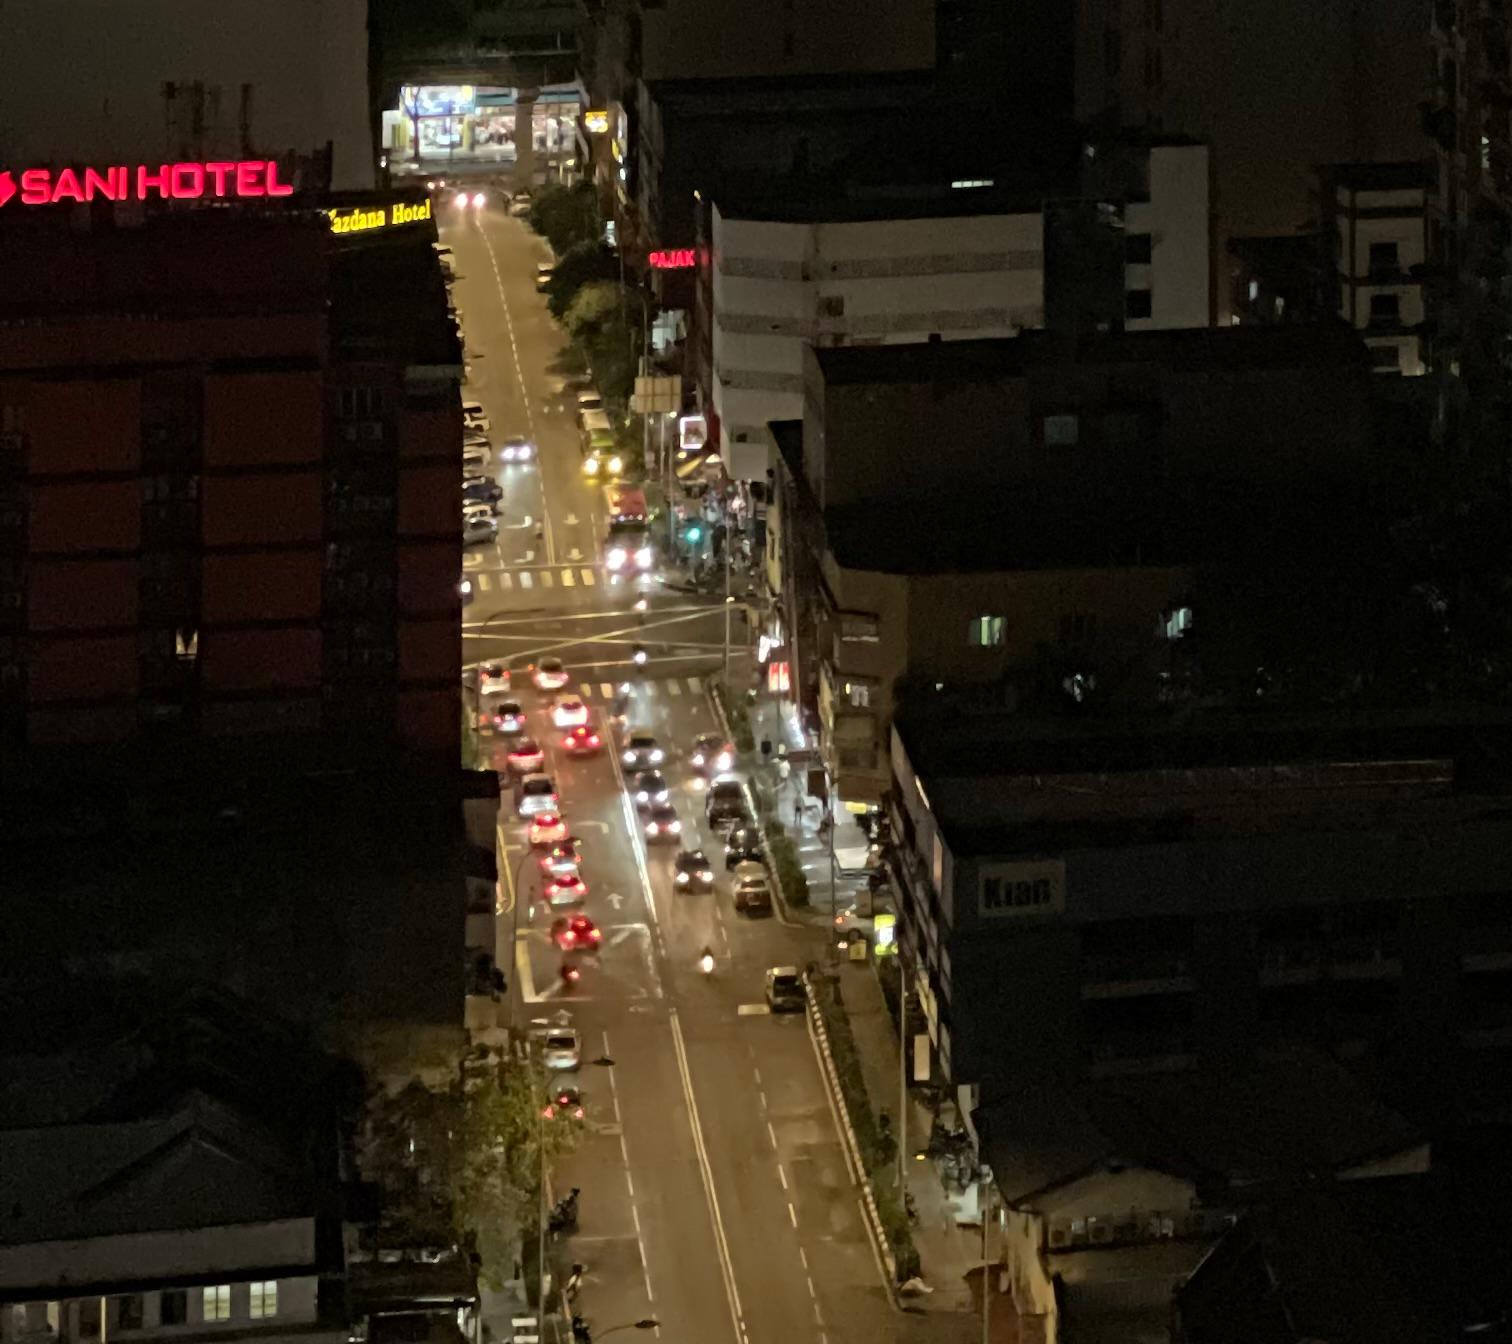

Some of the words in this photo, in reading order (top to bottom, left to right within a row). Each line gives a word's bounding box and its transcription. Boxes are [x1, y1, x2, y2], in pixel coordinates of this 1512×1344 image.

[21, 166, 128, 205] SANI
[137, 160, 294, 200] HOTEL
[392, 198, 431, 225] Hotel
